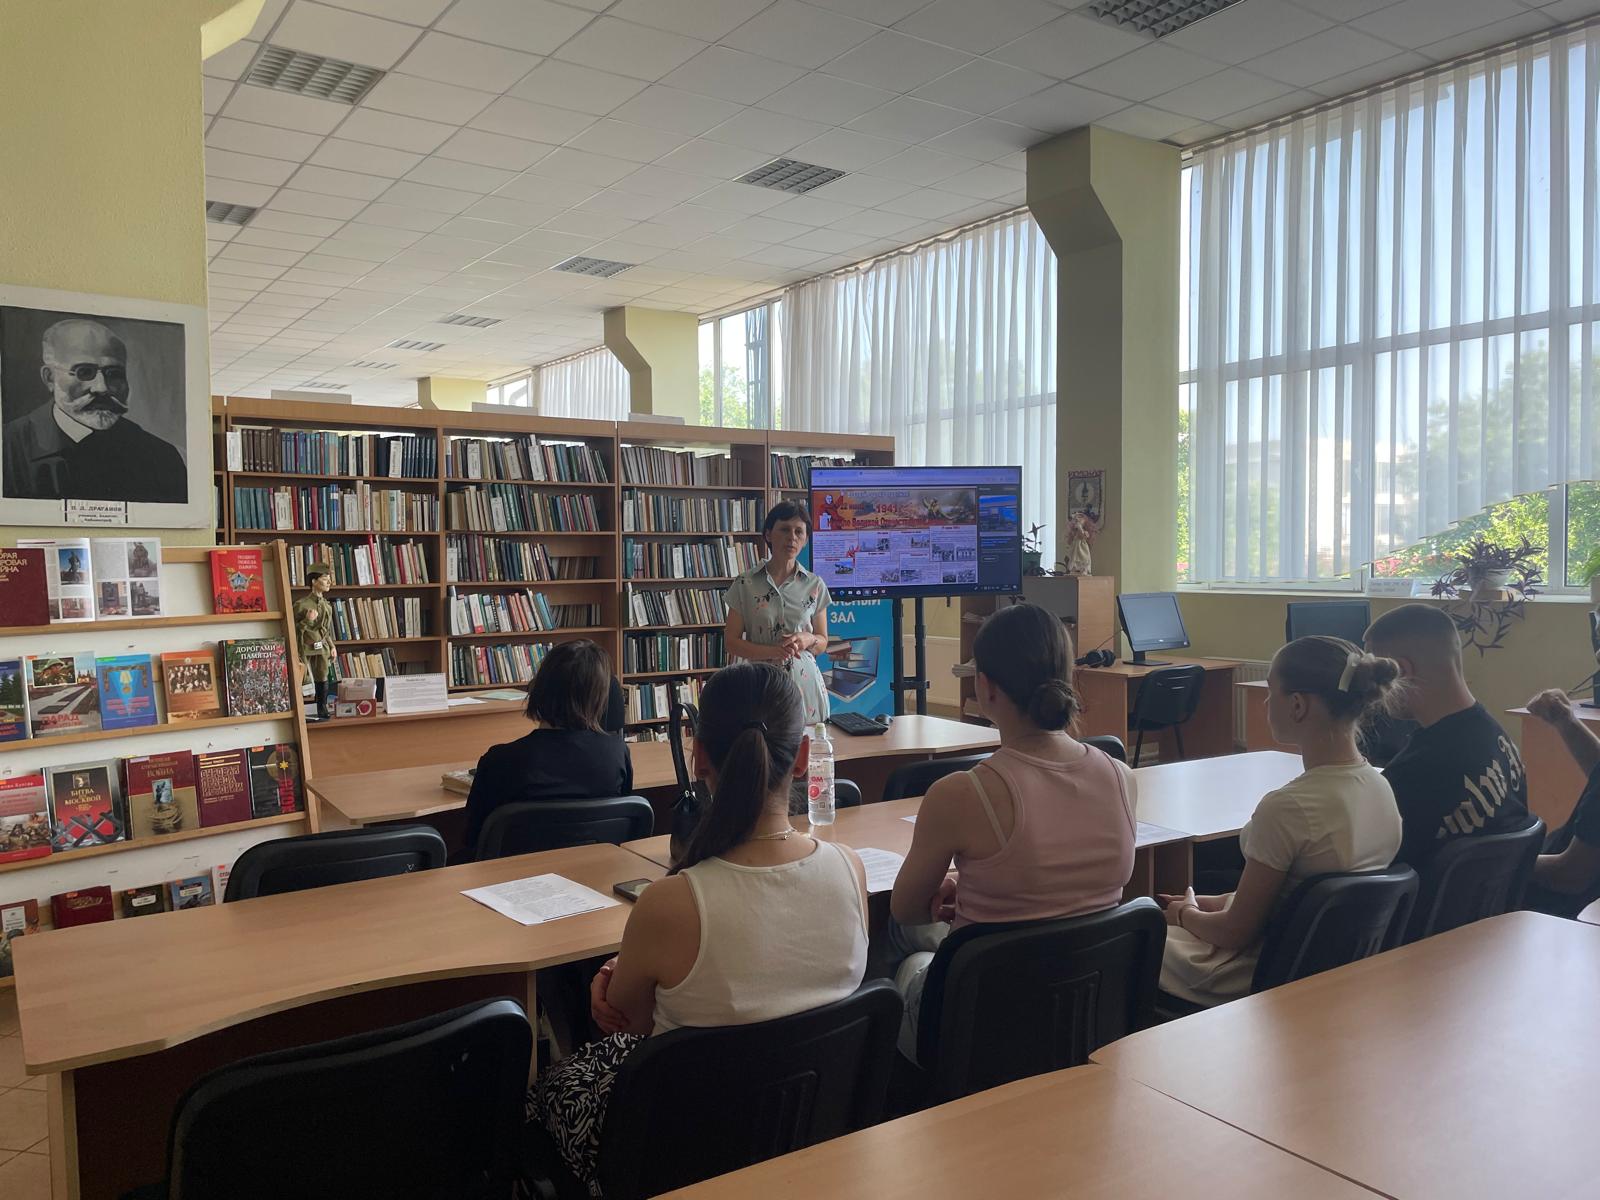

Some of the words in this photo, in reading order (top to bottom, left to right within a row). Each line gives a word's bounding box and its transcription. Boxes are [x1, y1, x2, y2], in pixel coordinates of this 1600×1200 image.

[876, 503, 898, 513] 1941
[830, 611, 856, 624] ЗАЛ
[236, 644, 276, 654] ДОРОГАМИ
[241, 652, 272, 660] ПАМЯТИ
